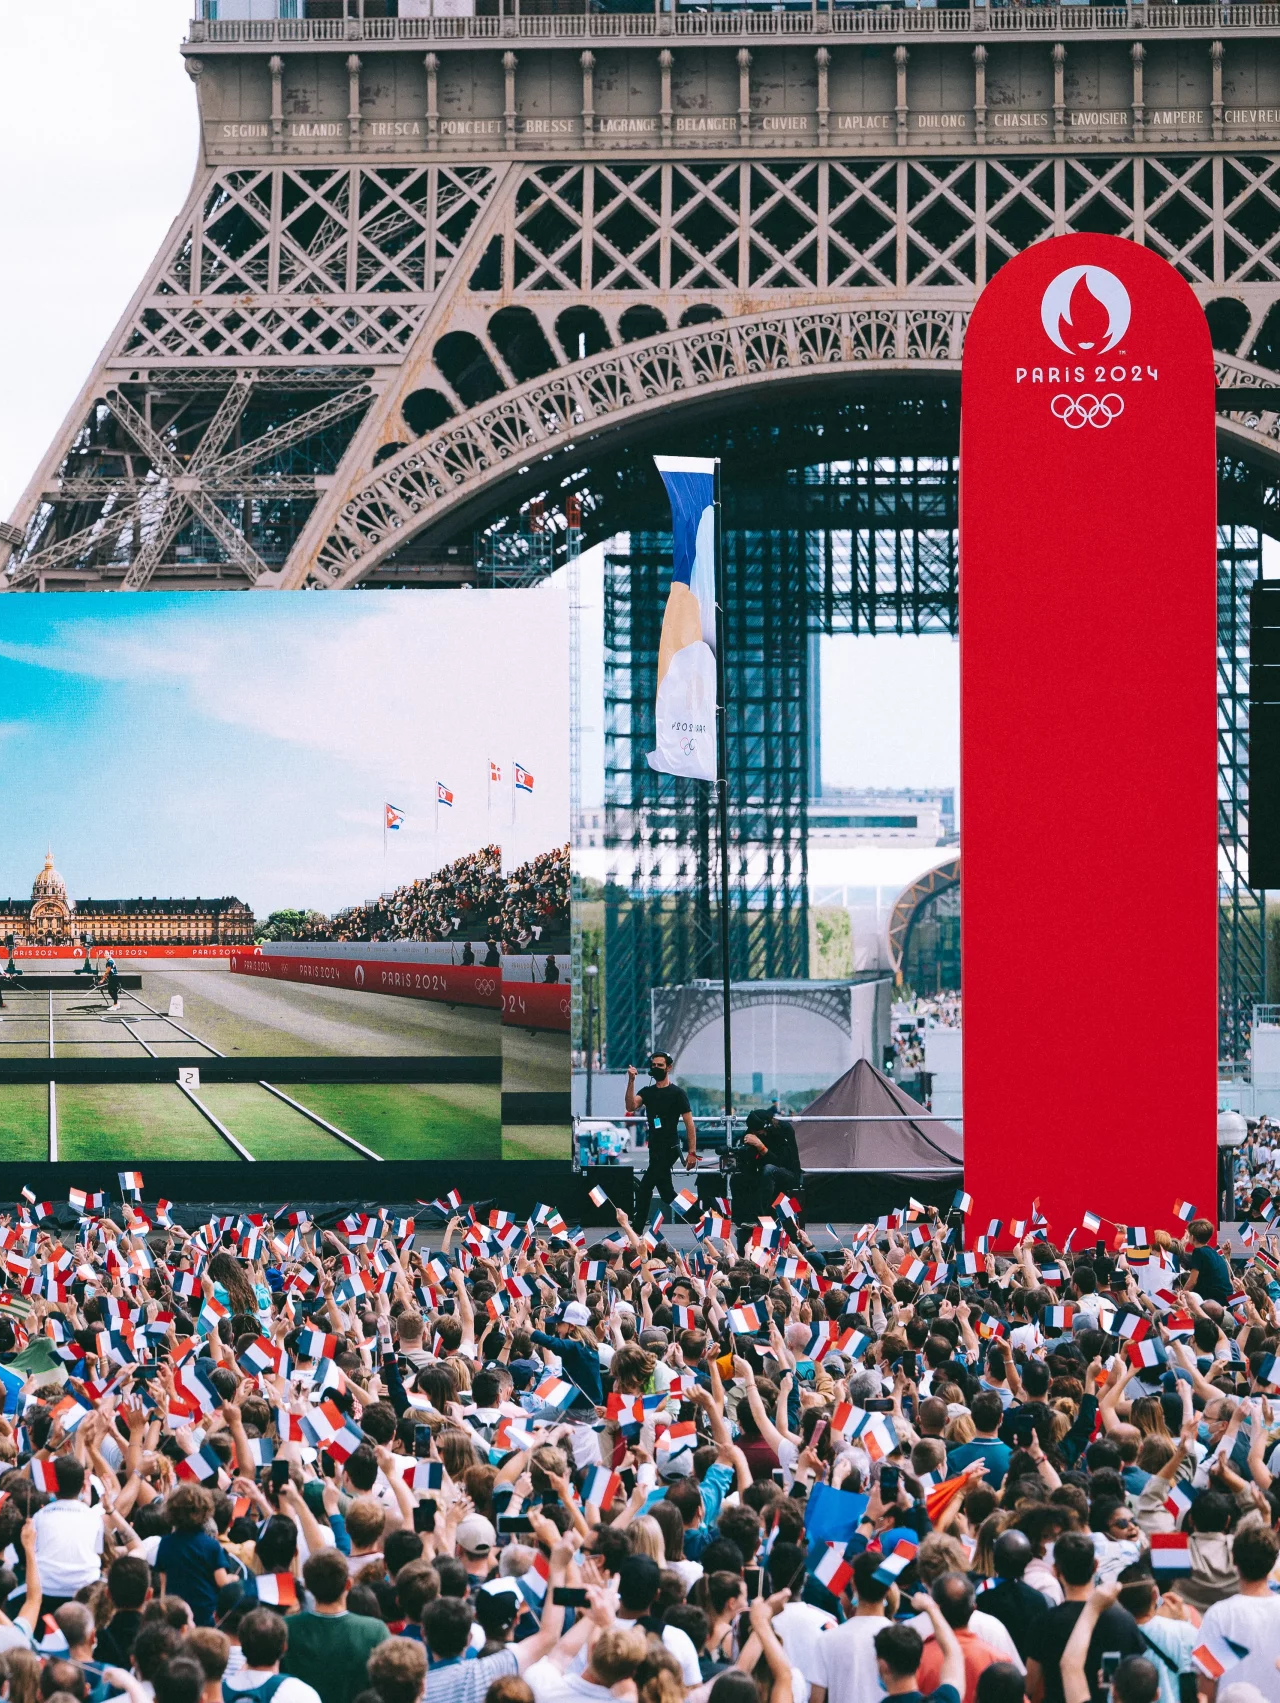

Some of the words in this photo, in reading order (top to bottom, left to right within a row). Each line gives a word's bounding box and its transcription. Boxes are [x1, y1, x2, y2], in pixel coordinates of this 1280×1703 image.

[223, 123, 268, 138] SEGUIN
[292, 123, 343, 137] LALANDE
[371, 122, 420, 135] TRESCA
[440, 120, 502, 134] PONCELET
[525, 119, 574, 133] BRESSE
[600, 118, 657, 132] LAGRANGE
[676, 117, 737, 131] BELANGER
[762, 116, 807, 130] CUVIER
[838, 115, 889, 129] LAPLACE
[918, 114, 966, 128] DULONG
[994, 113, 1048, 127] CHASLES
[1071, 112, 1127, 126] LAVOISIER
[1153, 111, 1204, 125] AMPERE
[1095, 365, 1158, 382] 2024
[320, 966, 341, 979] 2024
[415, 974, 448, 991] 2024
[185, 1072, 194, 1084] 2
